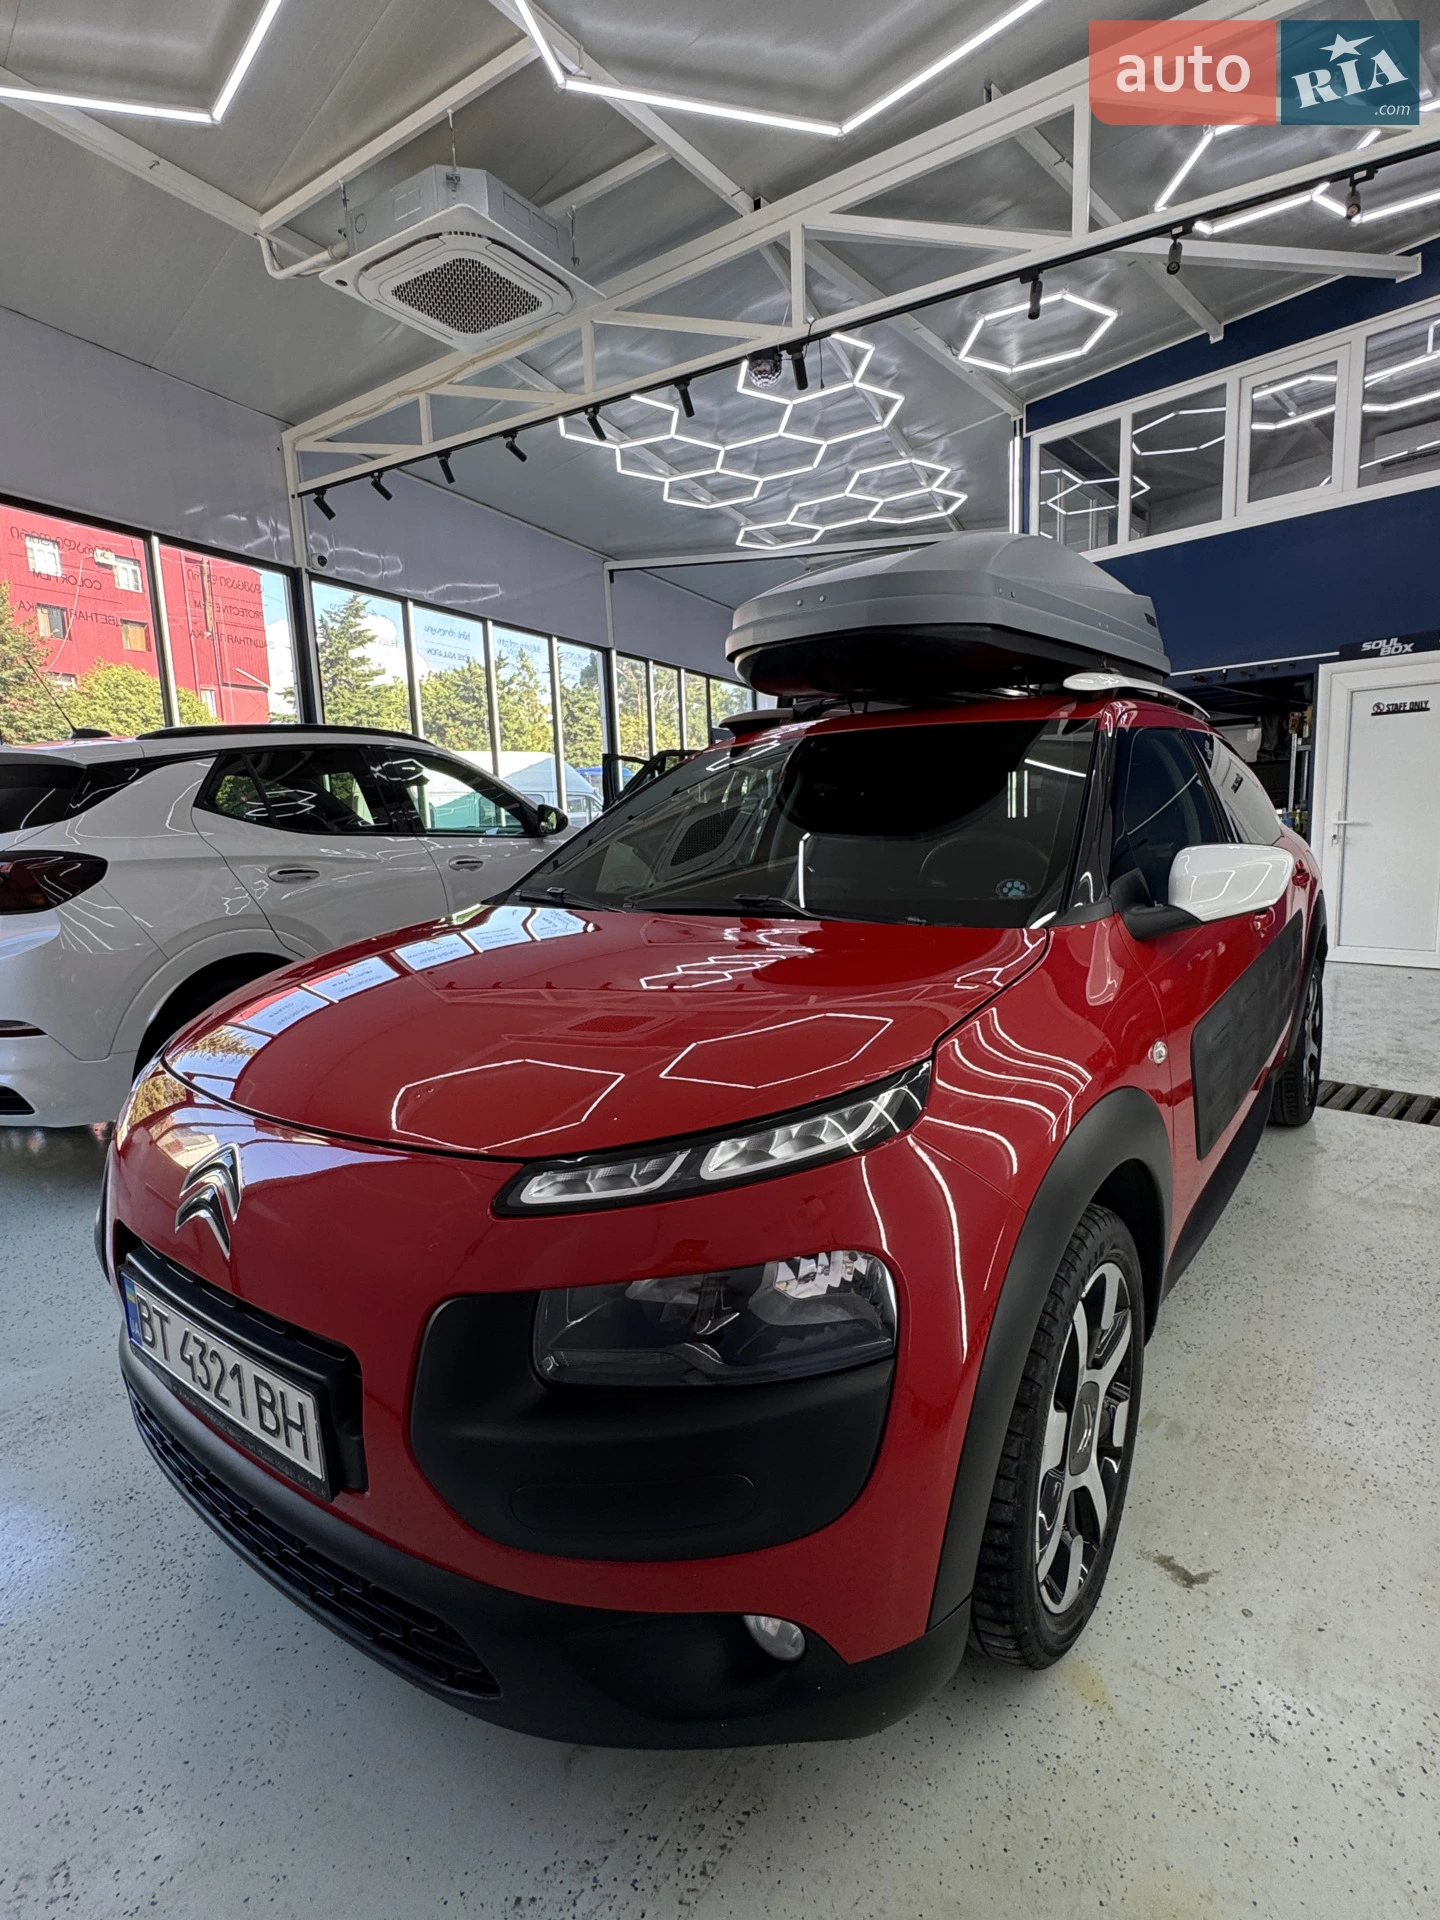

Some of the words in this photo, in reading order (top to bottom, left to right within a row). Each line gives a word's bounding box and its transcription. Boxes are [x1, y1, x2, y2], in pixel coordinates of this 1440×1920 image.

[1361, 637, 1402, 652] SOUL
[1380, 642, 1415, 656] BOX
[1386, 702, 1407, 712] STAFF
[1409, 700, 1430, 711] ONLY
[179, 1327, 247, 1419] 4321
